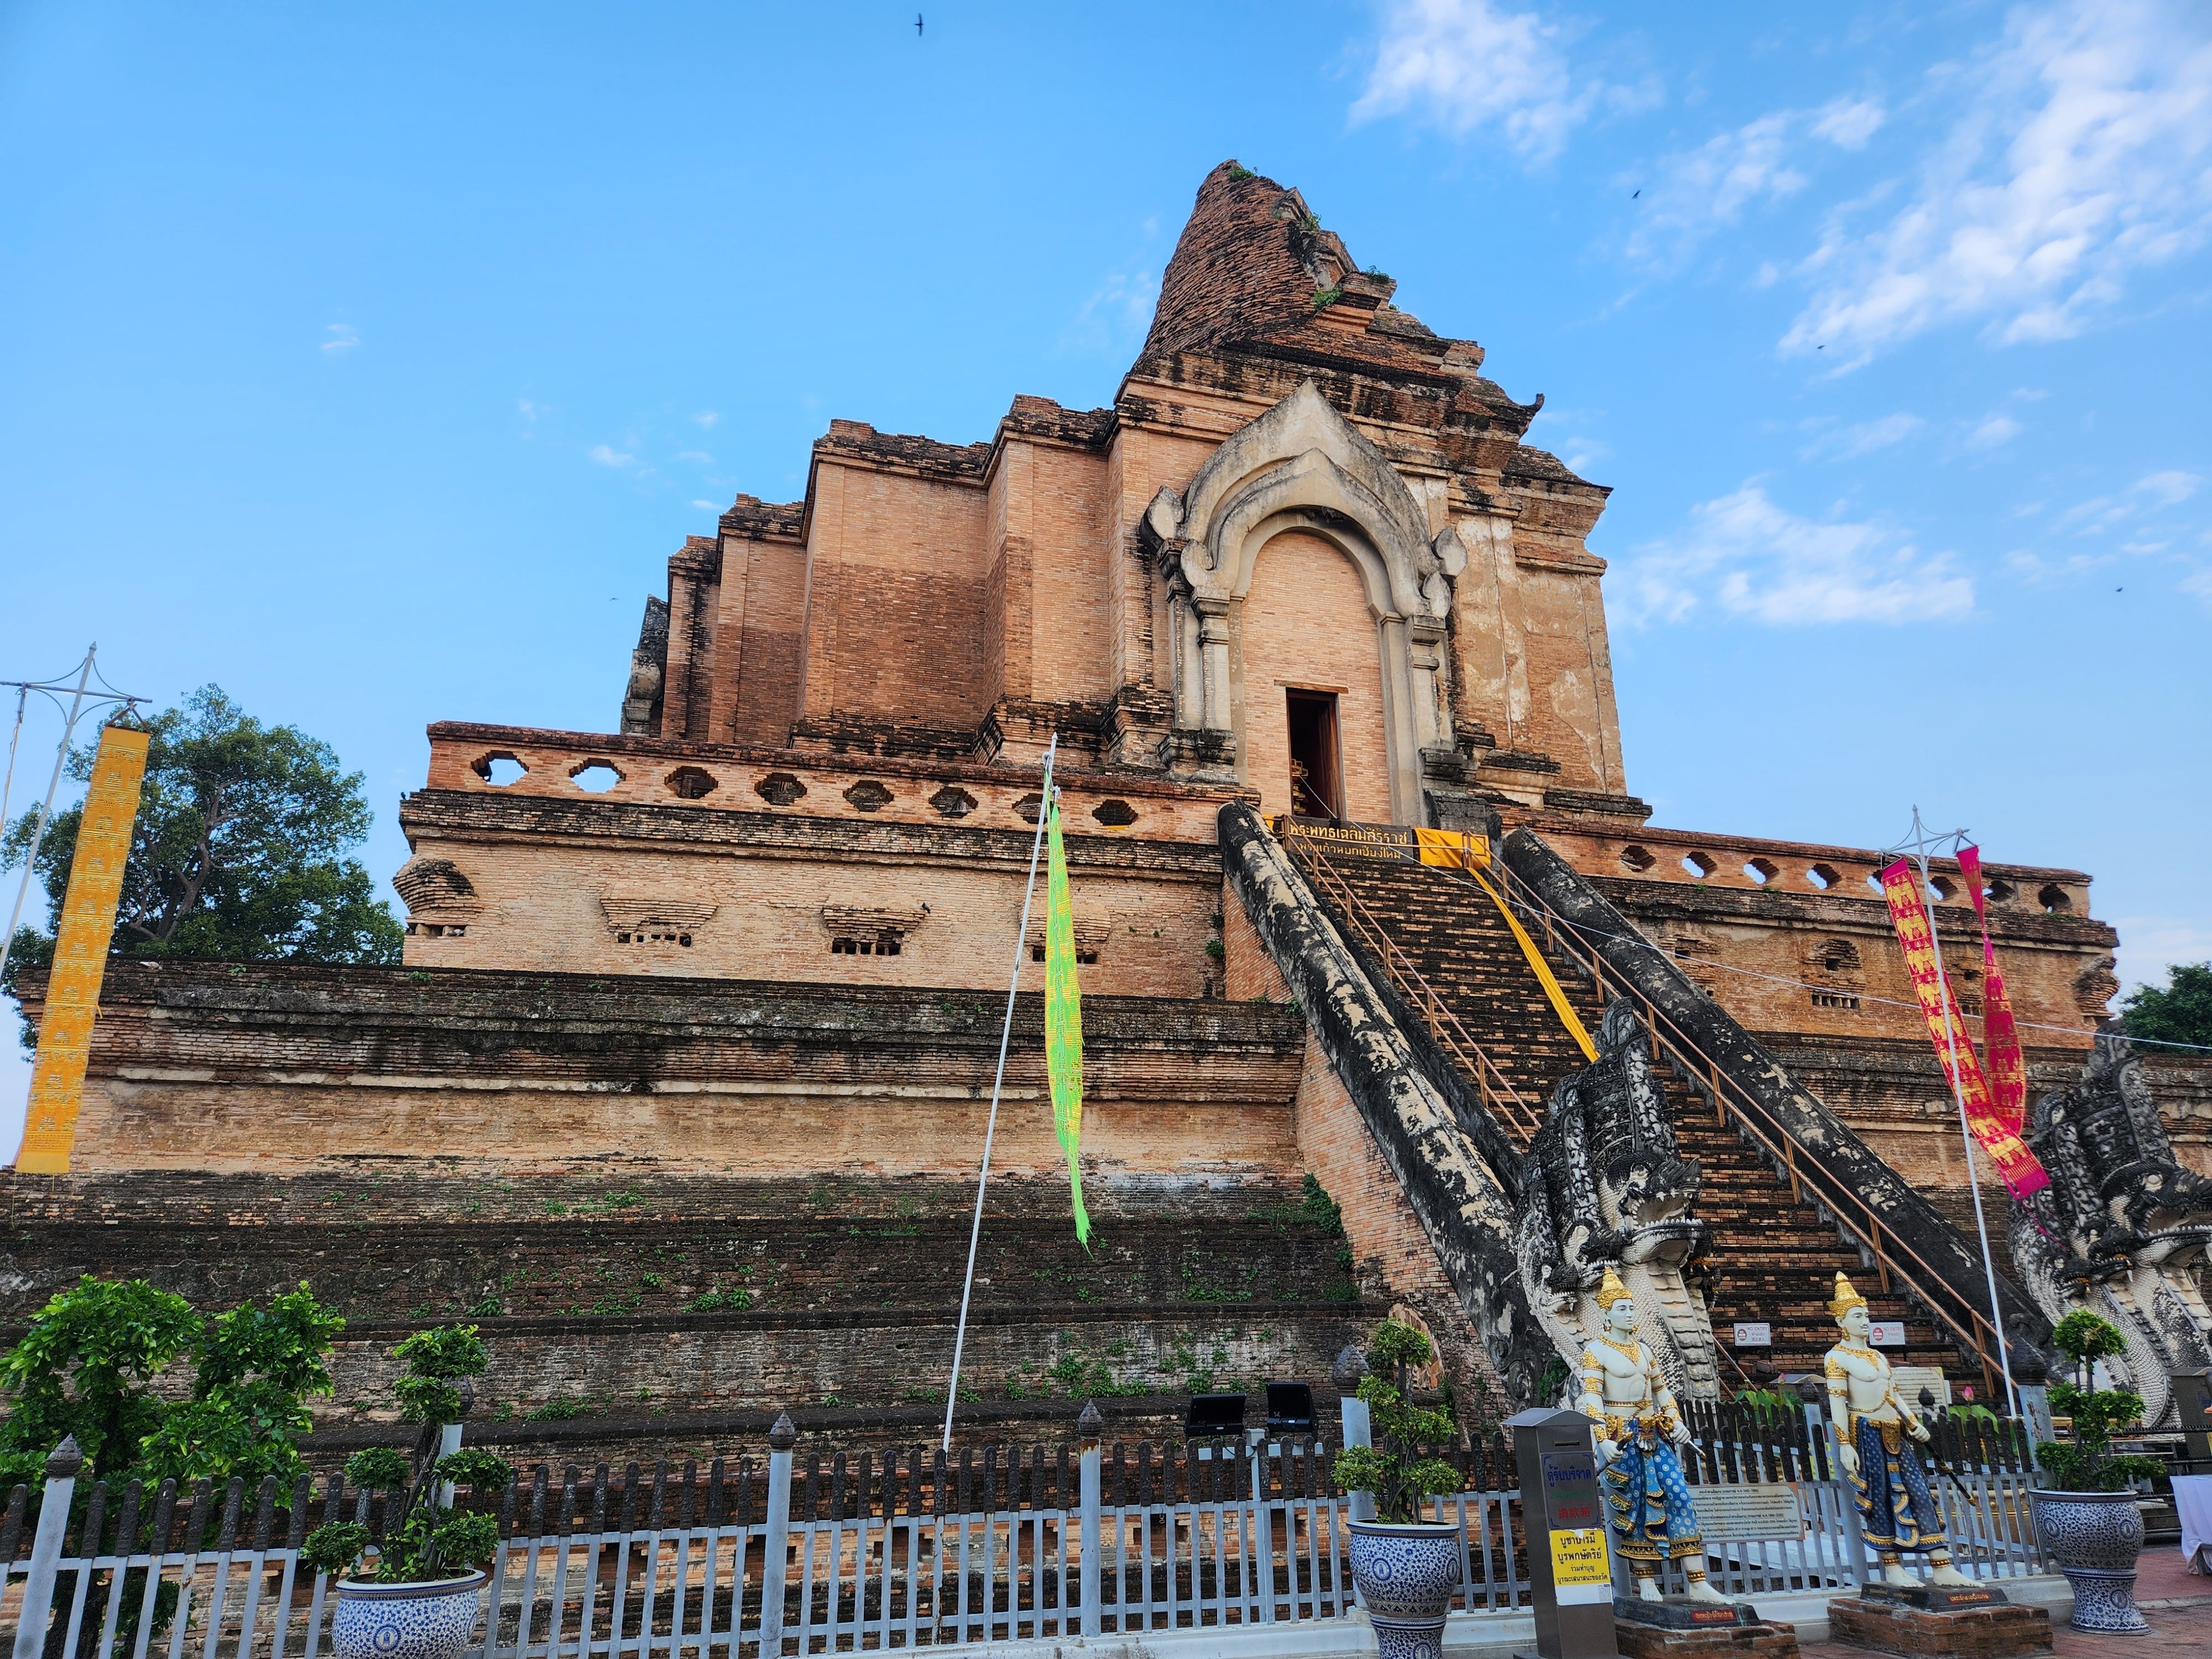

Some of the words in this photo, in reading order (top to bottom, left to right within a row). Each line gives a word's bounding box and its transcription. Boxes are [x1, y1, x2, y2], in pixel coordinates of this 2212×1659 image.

[1290, 824, 1407, 844] พระพทธเฉลิมสิริราช
[1548, 1464, 1592, 1487] ตู้รับบริจาค
[1560, 1532, 1595, 1548] บูชาบารมี
[1557, 1547, 1601, 1564] บูรพกษัตริย์
[1571, 1564, 1595, 1573] ร่วมทำบุญ
[1557, 1573, 1608, 1584] บูรณะเสนาสนะของวัด
